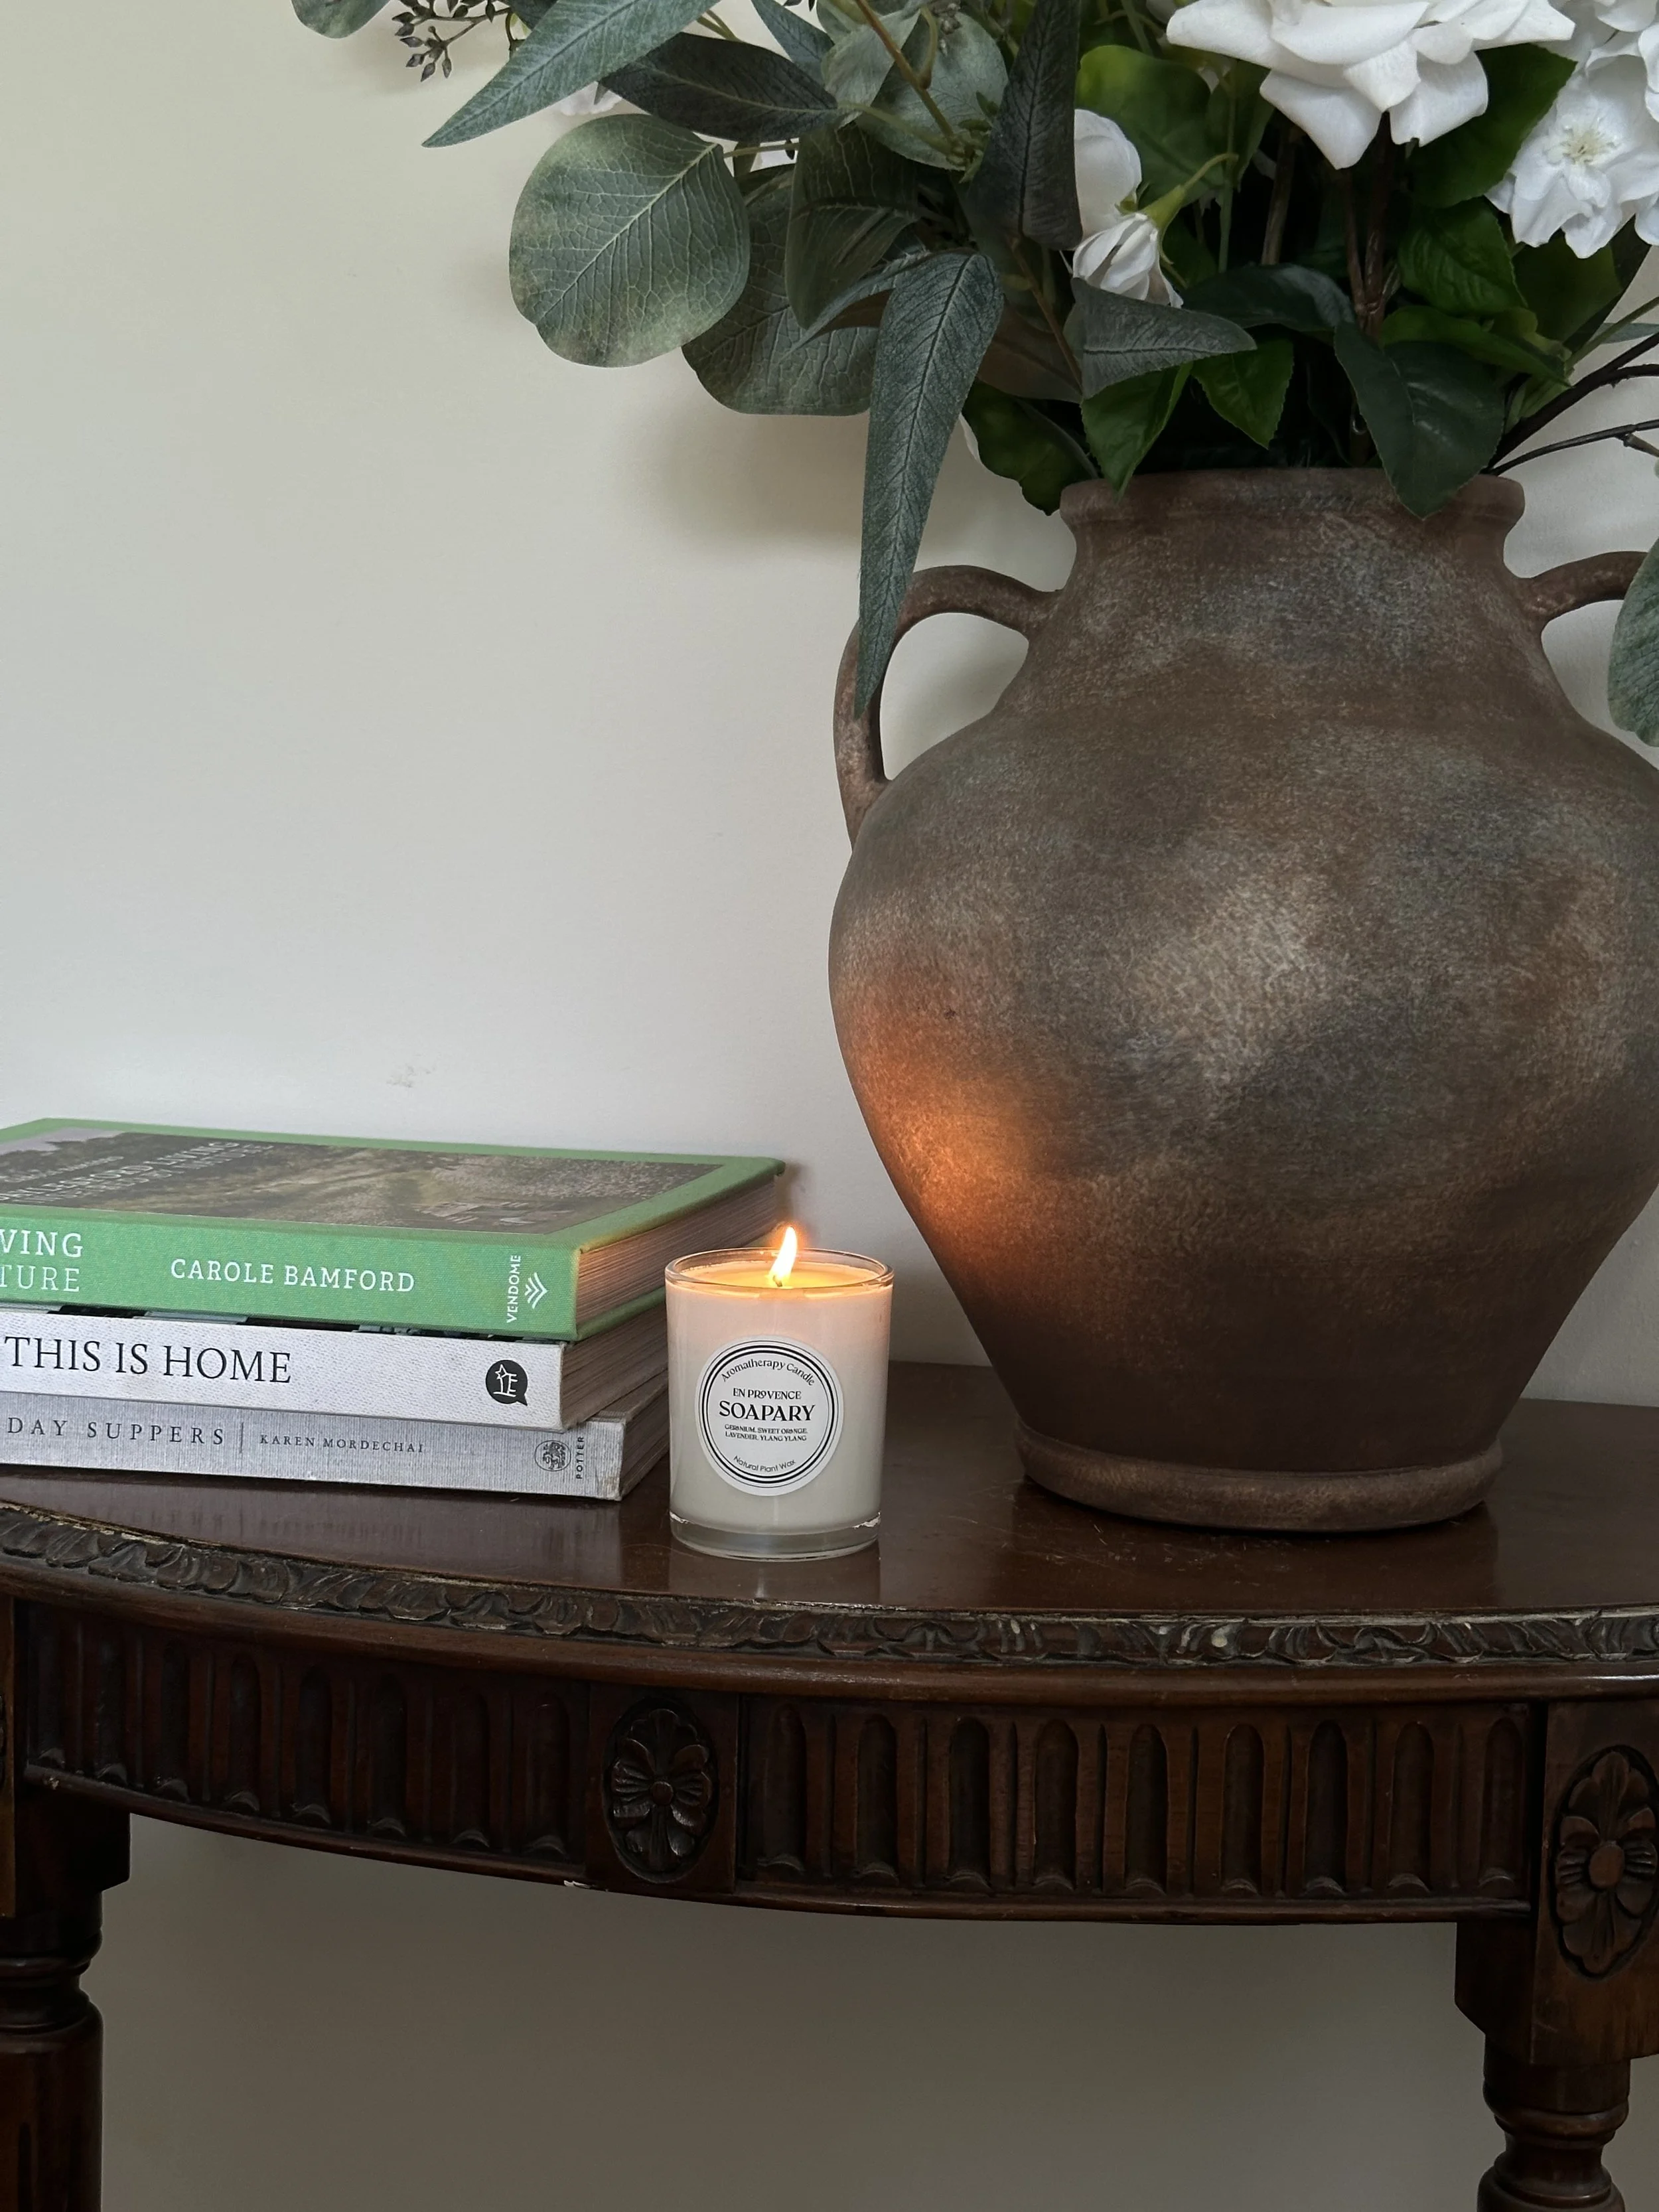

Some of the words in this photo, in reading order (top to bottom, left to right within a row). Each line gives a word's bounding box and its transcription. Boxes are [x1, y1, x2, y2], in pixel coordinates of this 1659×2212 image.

[171, 1258, 274, 1284] CAROLE
[283, 1265, 415, 1293] BAMFORD
[506, 1254, 522, 1323] VENDOME
[5, 1335, 101, 1372] THIS
[115, 1342, 149, 1375] IS
[163, 1345, 292, 1384] HOME
[721, 1359, 786, 1382] Aromatherapy
[786, 1363, 815, 1386] Candle
[733, 1387, 746, 1398] EN
[747, 1389, 802, 1400] PROVENCE
[719, 1400, 816, 1422] SOAPARY
[7, 1416, 68, 1436] DAY
[87, 1421, 224, 1445] SUPPERS
[259, 1434, 316, 1447] KAREN
[323, 1438, 425, 1453] MORDECHAI
[575, 1436, 585, 1480] POTTER
[733, 1455, 759, 1471] Natural
[778, 1459, 796, 1469] Wax
